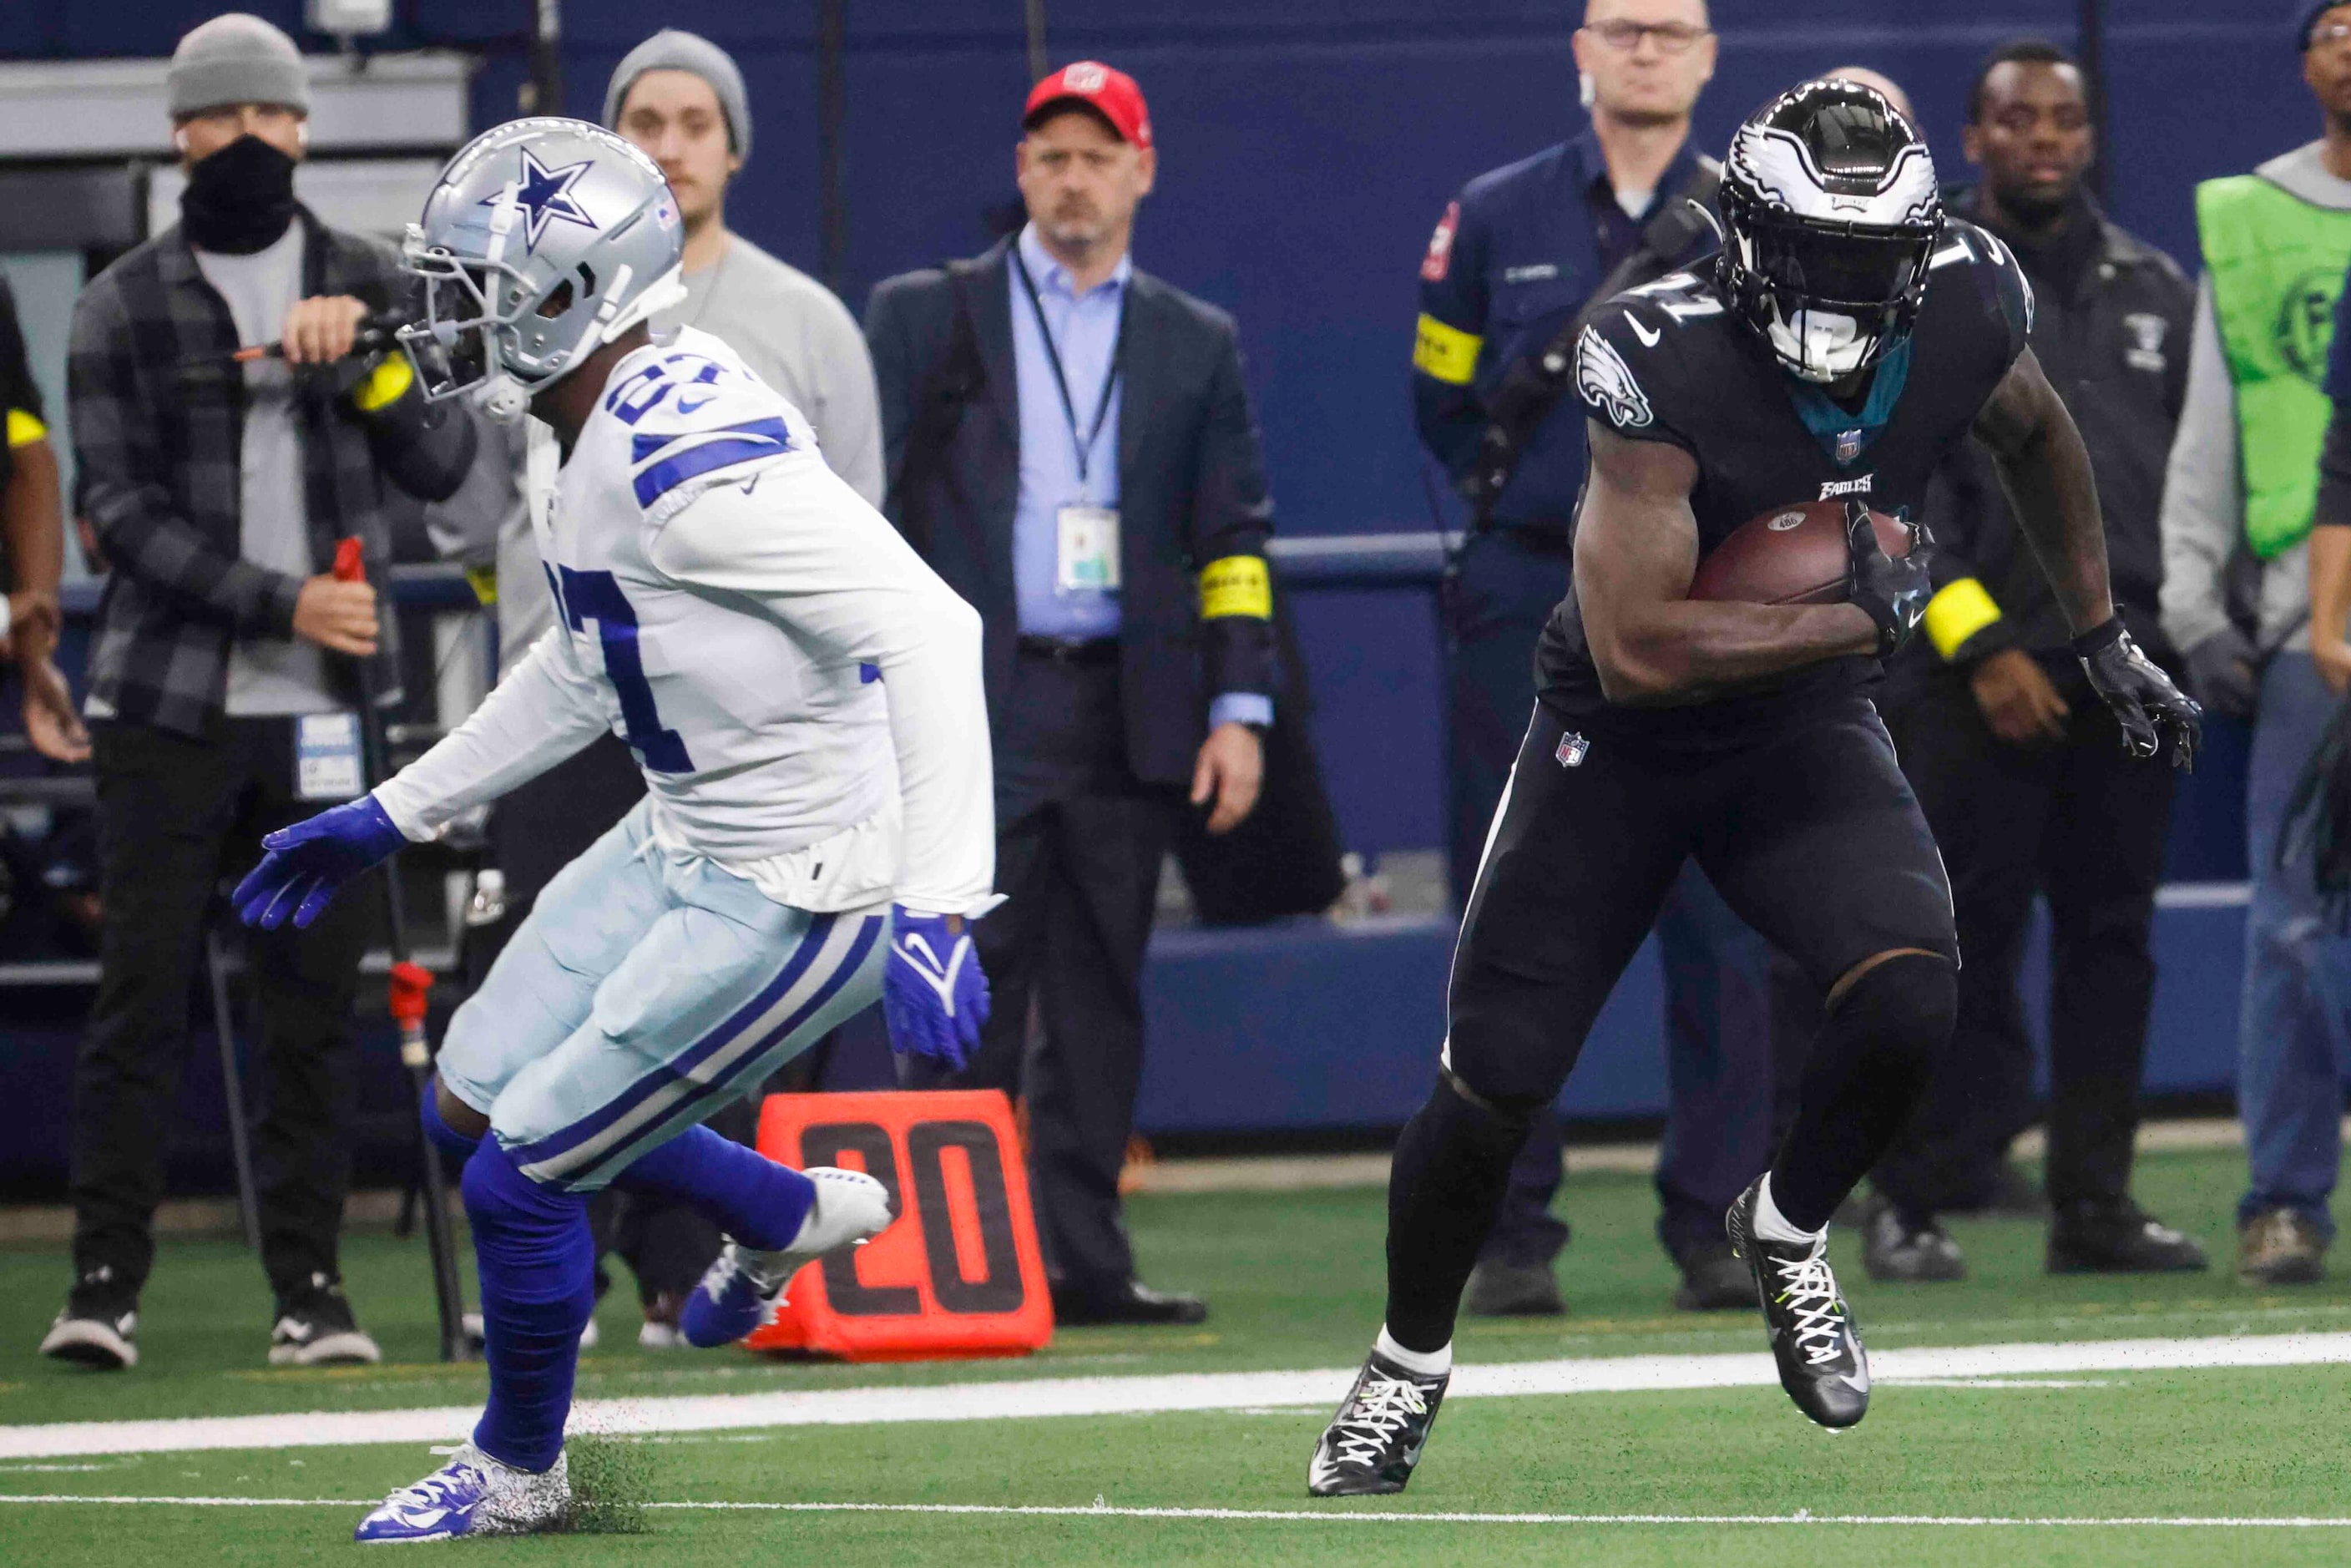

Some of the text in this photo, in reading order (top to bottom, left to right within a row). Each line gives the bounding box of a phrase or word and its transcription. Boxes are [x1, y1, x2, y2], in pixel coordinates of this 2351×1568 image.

[604, 352, 731, 427] 27
[1818, 473, 1873, 502] EAGLES
[799, 1120, 1026, 1318] 20
